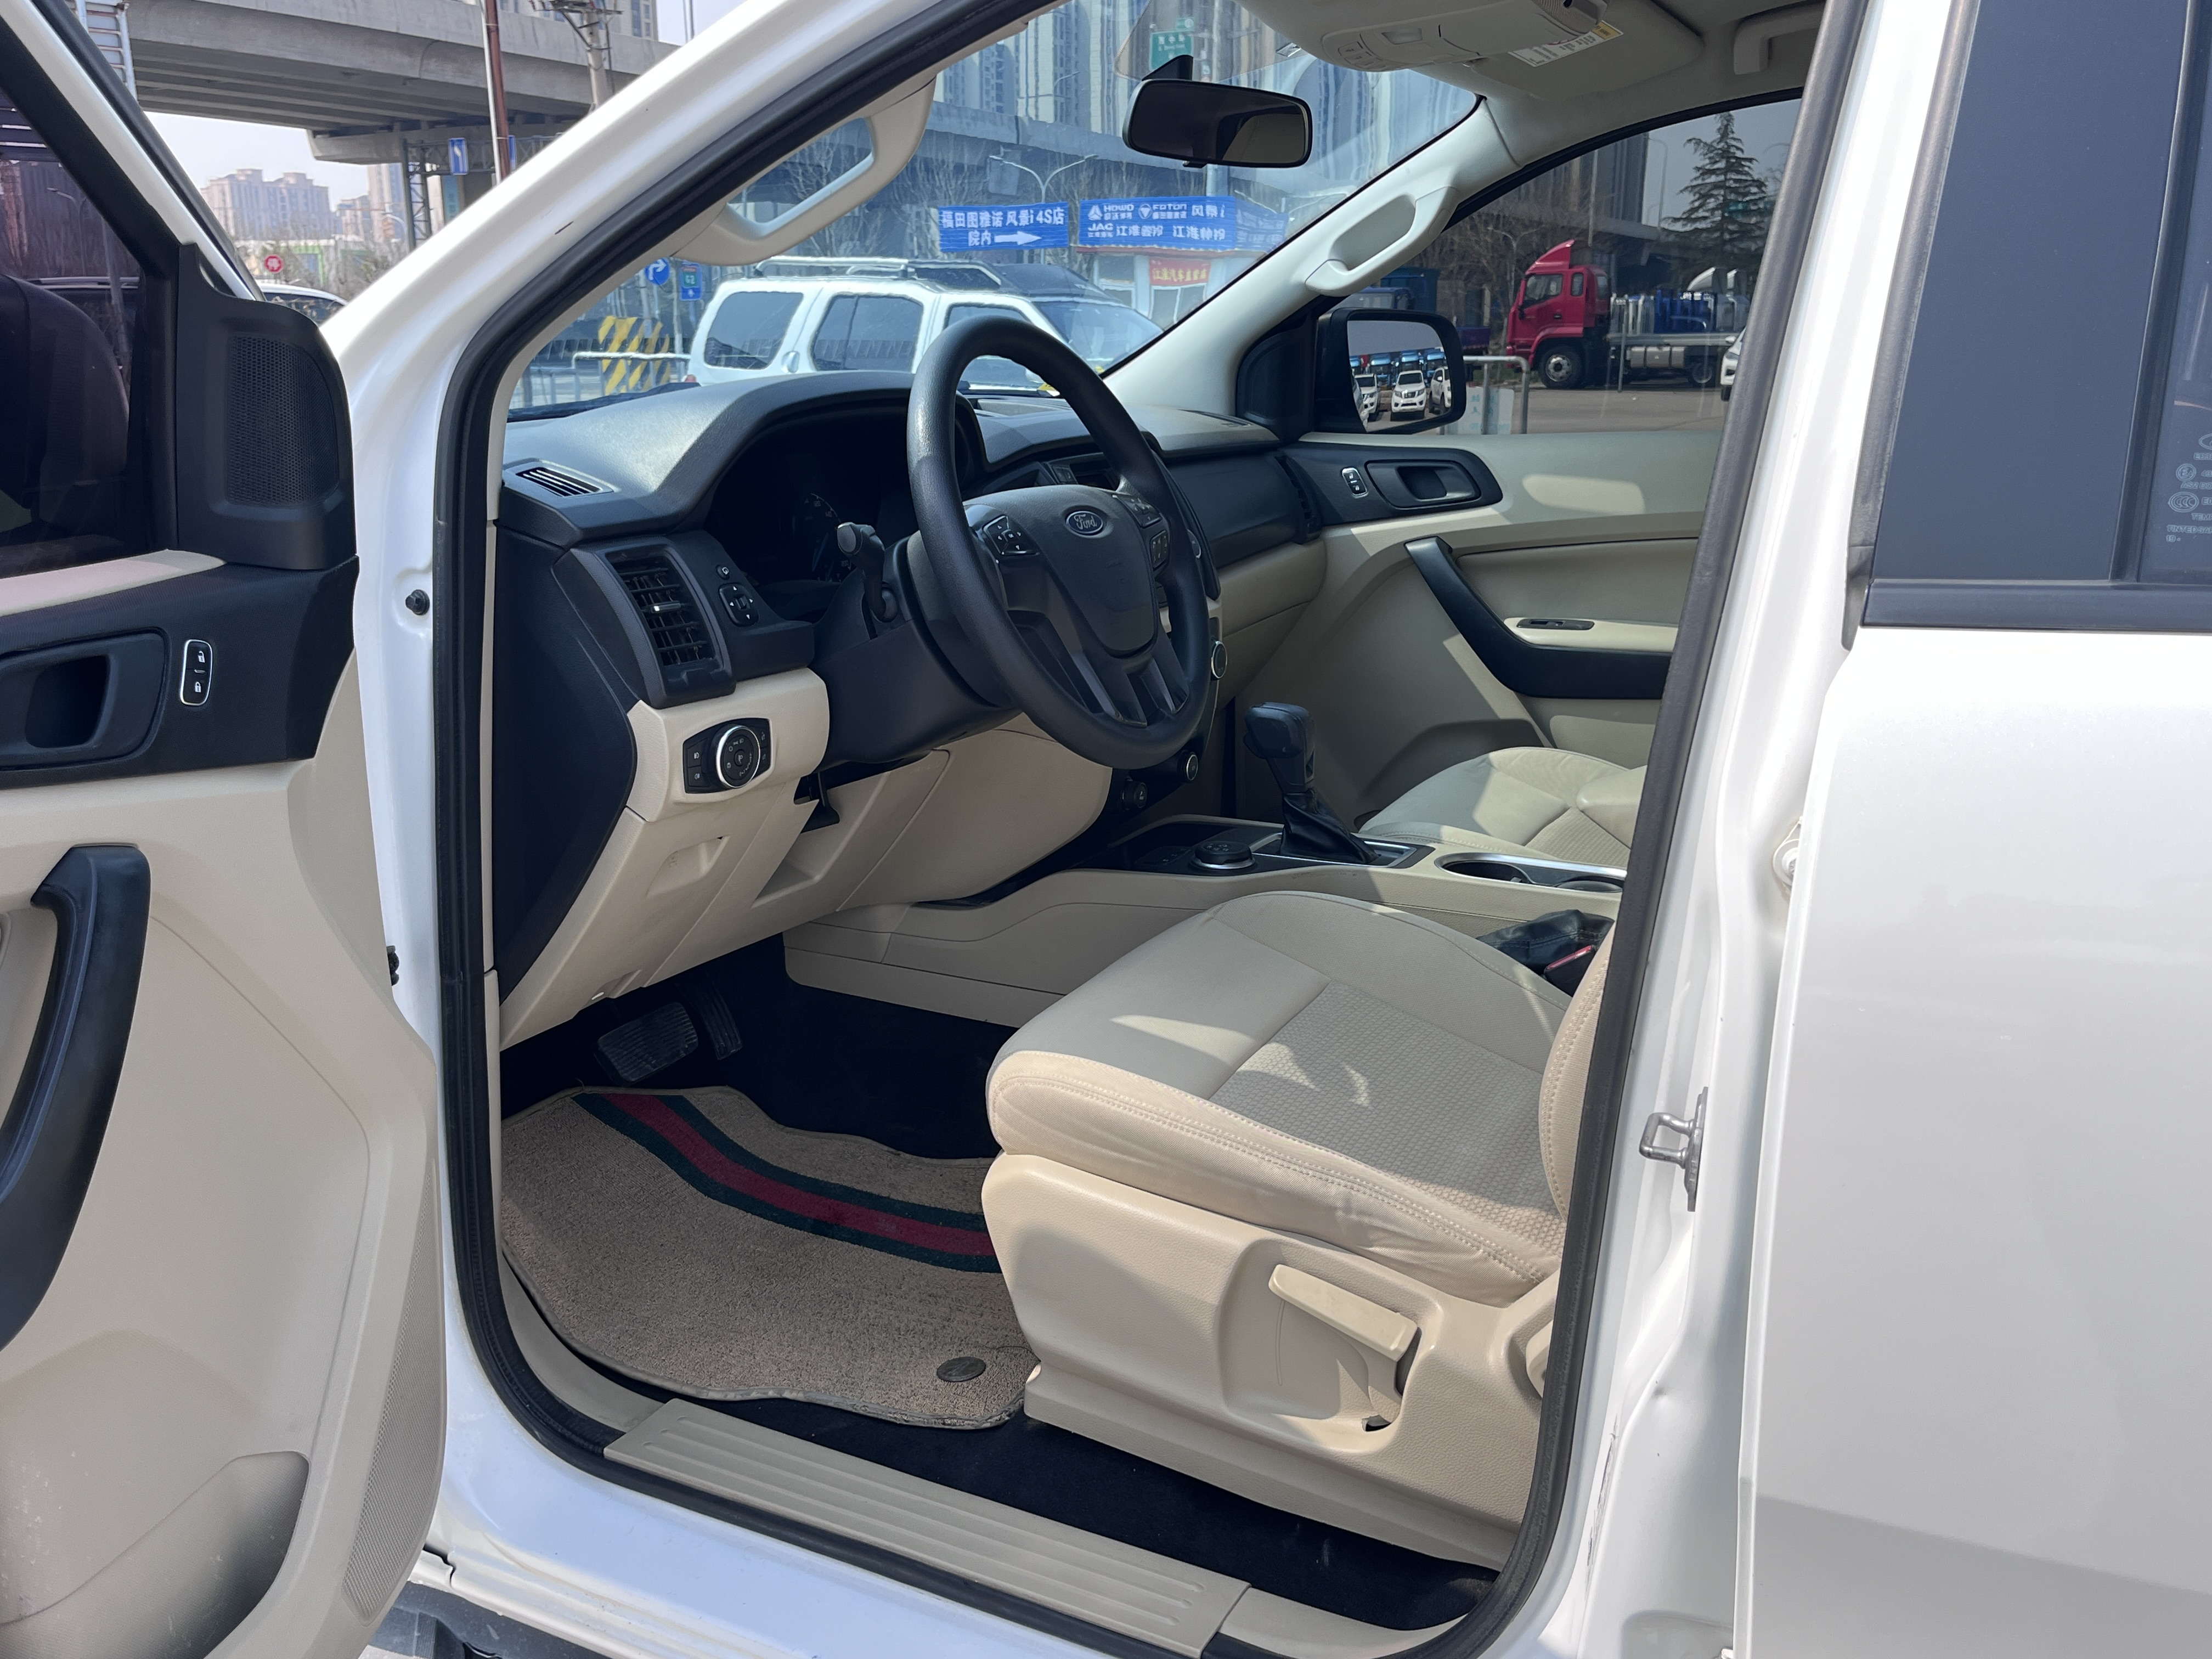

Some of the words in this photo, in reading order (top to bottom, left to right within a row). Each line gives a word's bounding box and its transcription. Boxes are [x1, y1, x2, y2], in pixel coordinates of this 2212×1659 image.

[1036, 207, 1065, 225] 4S店
[968, 230, 991, 246] 院内
[1074, 514, 1097, 529] Ford
